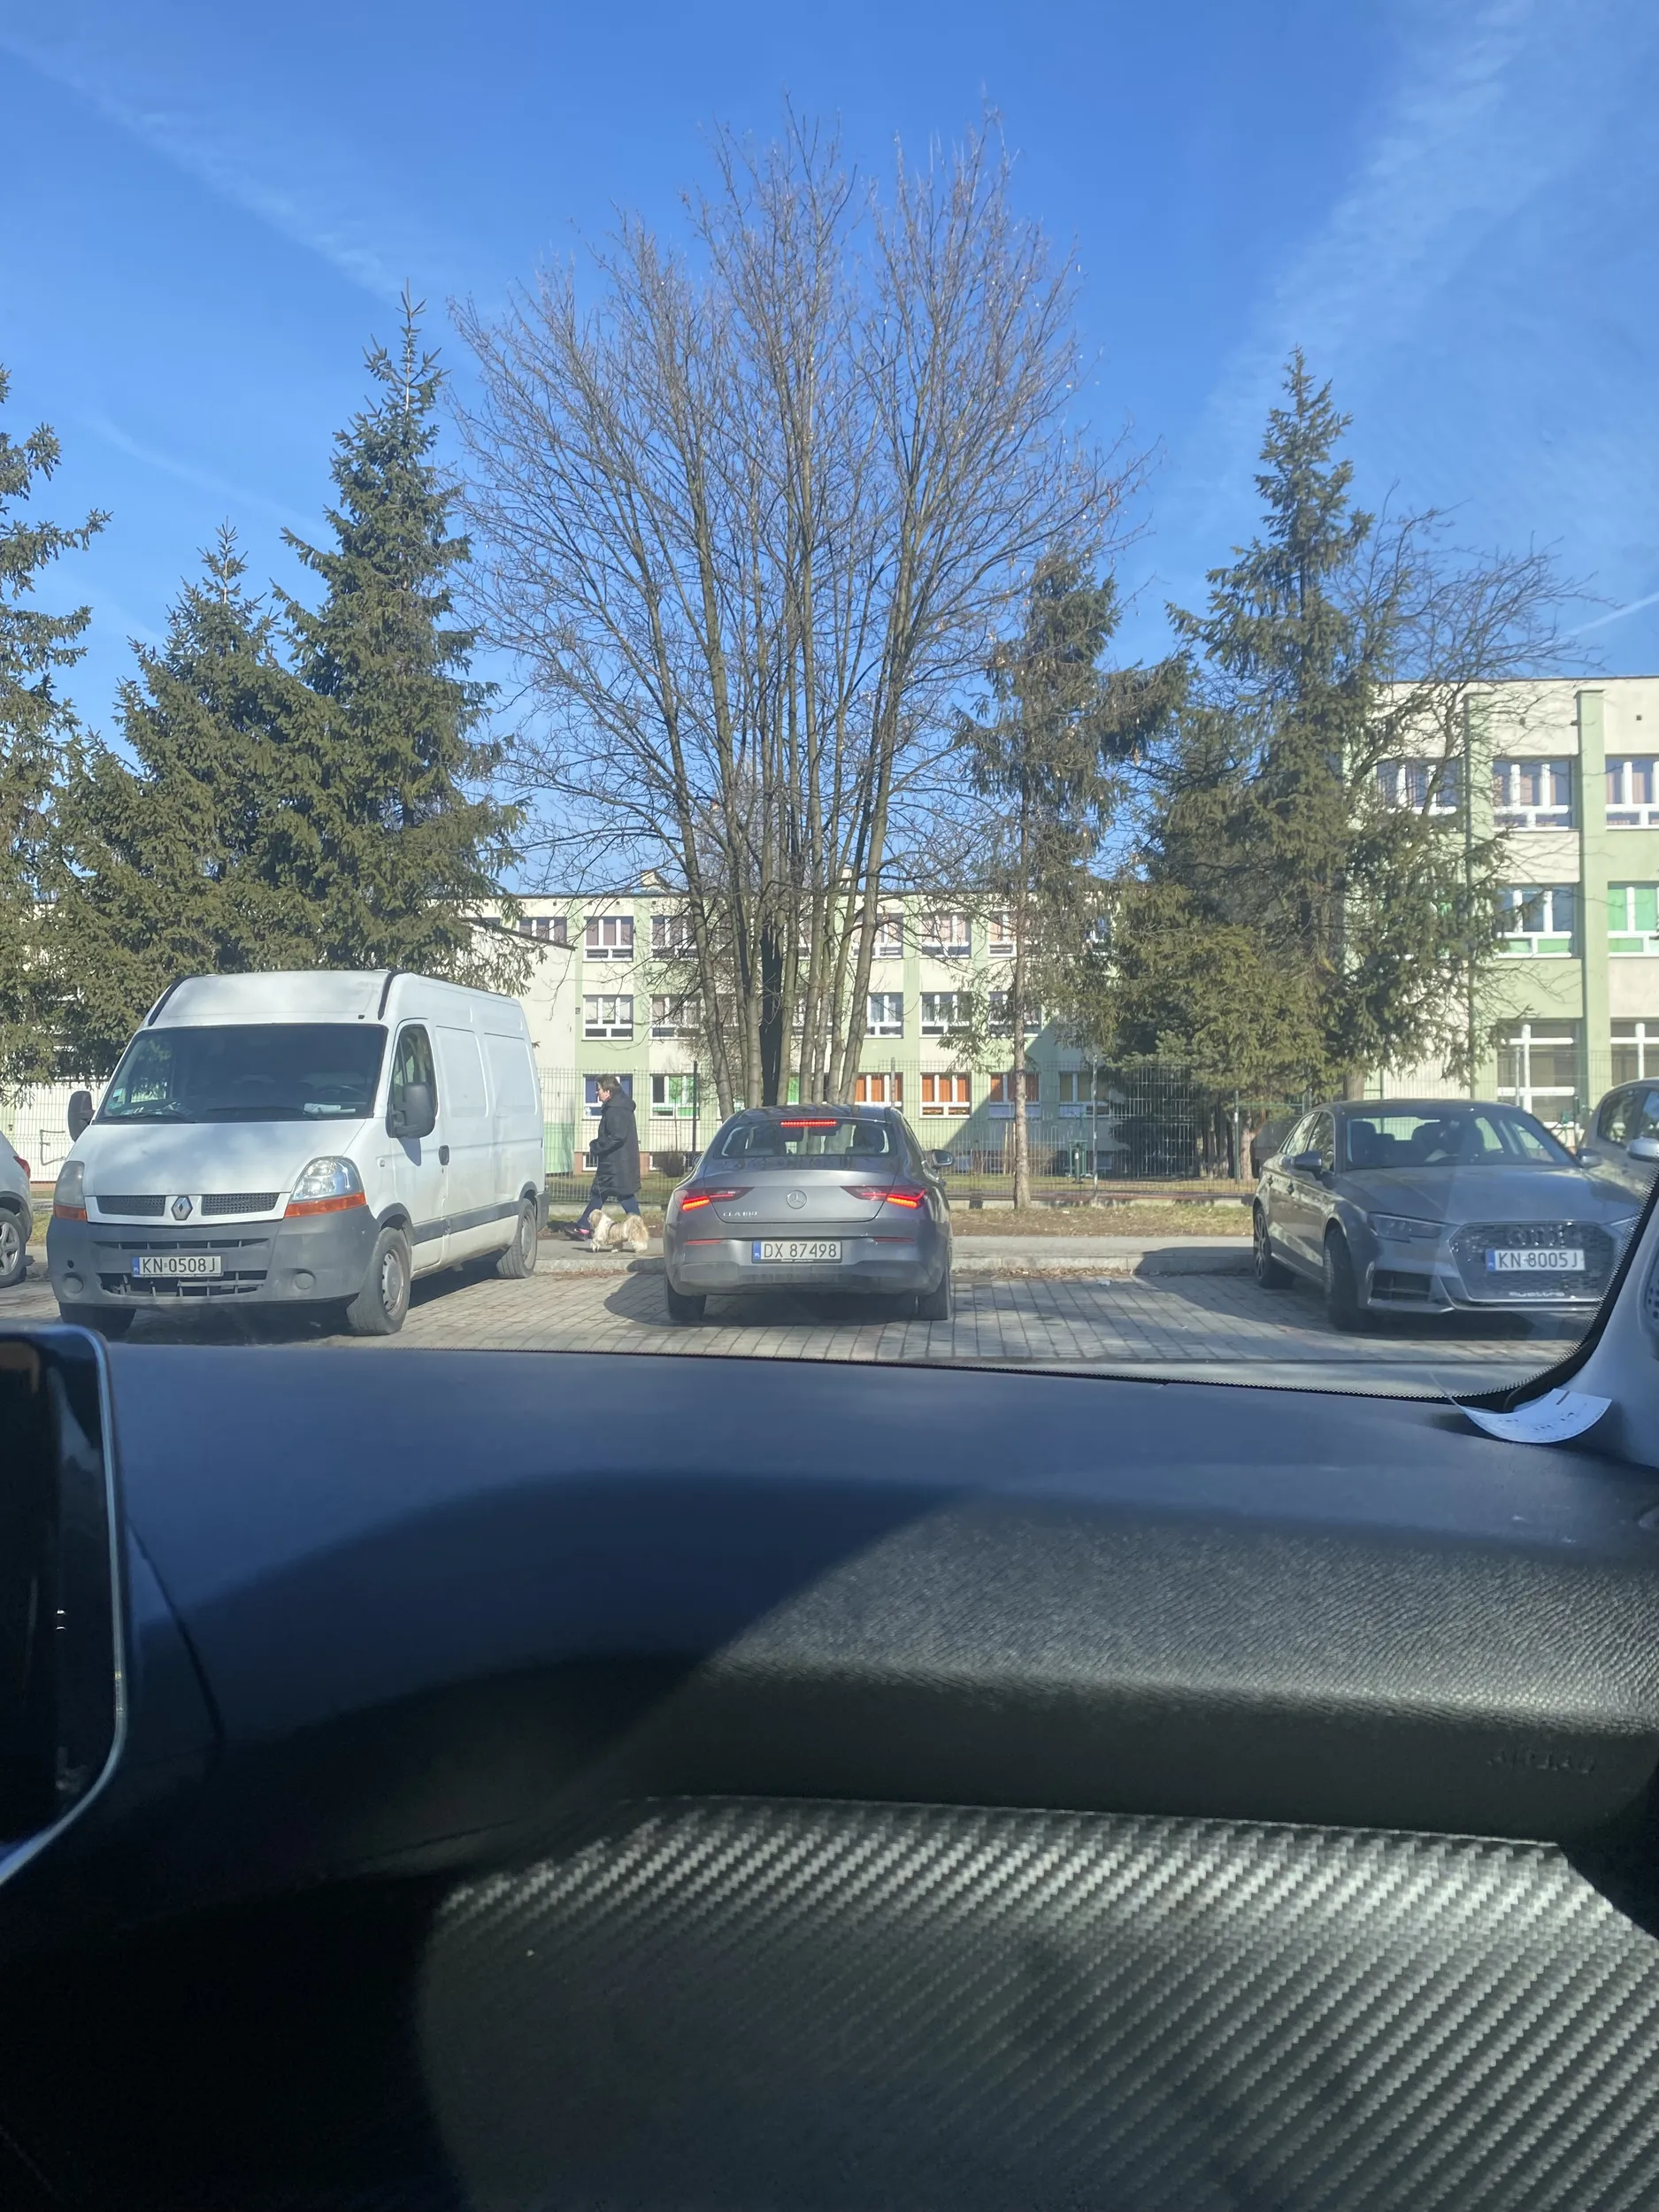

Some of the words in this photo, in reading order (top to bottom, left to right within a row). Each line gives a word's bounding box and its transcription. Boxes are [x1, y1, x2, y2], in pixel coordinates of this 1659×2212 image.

[764, 1243, 784, 1258] DX
[789, 1243, 837, 1258] 87498
[142, 1258, 163, 1273] KN
[168, 1257, 215, 1273] 0508J
[1498, 1252, 1521, 1269] KN
[1527, 1252, 1578, 1268] 8005J
